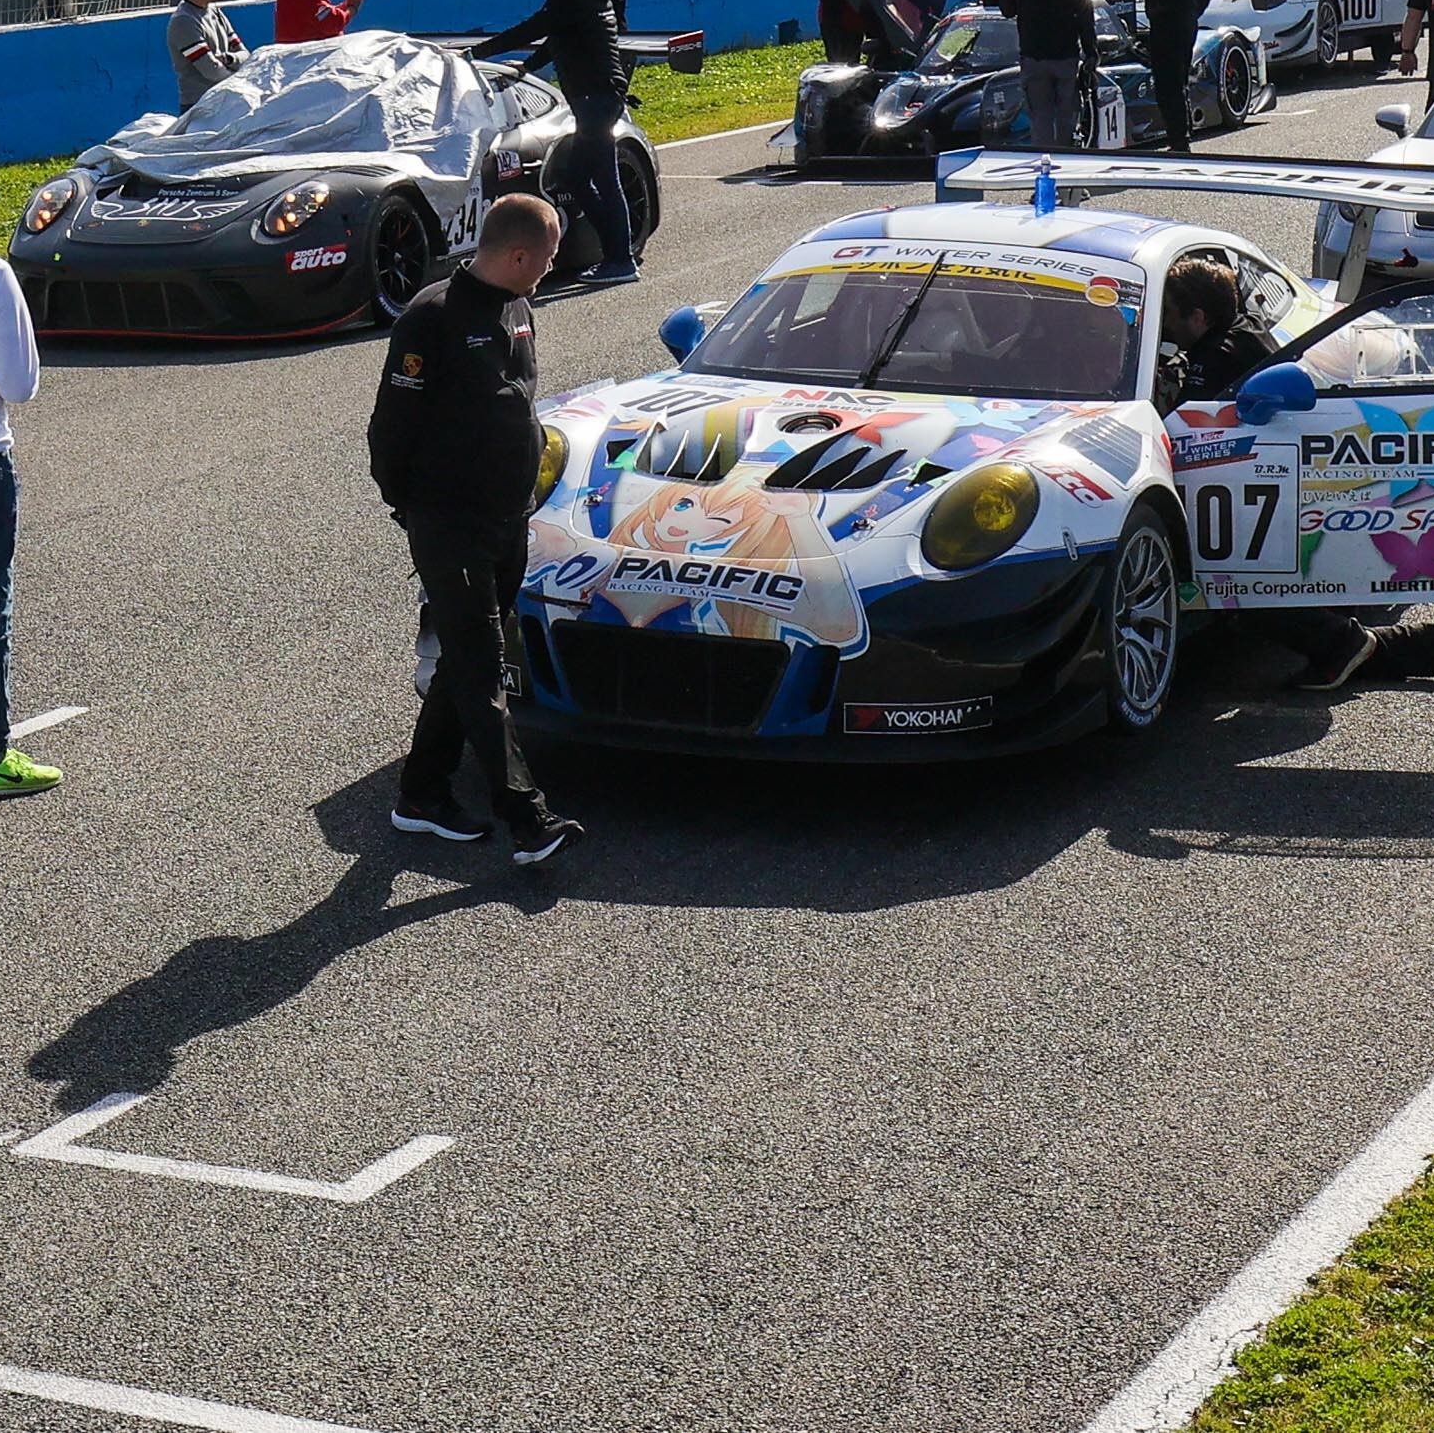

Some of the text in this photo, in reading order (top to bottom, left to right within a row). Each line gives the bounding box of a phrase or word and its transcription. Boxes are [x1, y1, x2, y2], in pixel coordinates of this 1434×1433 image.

[1104, 106, 1119, 141] 14
[290, 251, 347, 271] auto
[293, 246, 324, 260] sport
[832, 245, 1101, 278] GT WINTER SERIES
[620, 388, 734, 417] 107
[1184, 449, 1232, 464] SERIES
[1189, 440, 1237, 455] WINTER
[1302, 469, 1416, 479] RACING TEAM
[1300, 509, 1395, 532] GOOD
[612, 556, 804, 601] PACIFIC
[608, 582, 713, 598] RACING TEAM
[1205, 579, 1347, 599] Fujita Corporation
